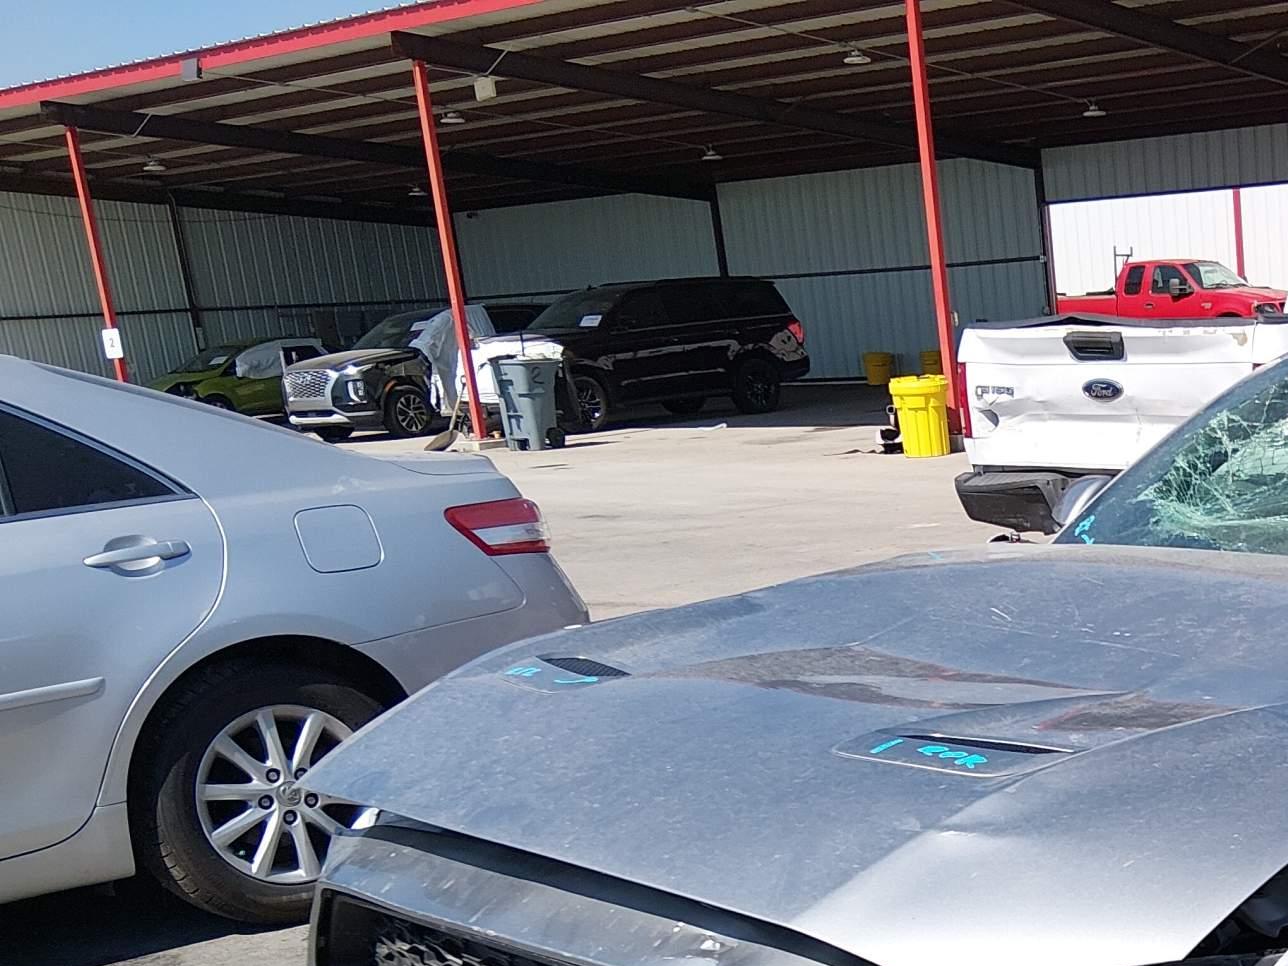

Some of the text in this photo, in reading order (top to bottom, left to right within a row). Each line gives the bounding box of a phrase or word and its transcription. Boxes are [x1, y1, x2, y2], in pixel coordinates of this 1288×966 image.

[109, 337, 116, 348] 2
[531, 366, 545, 384] 2
[1090, 382, 1114, 397] Ford
